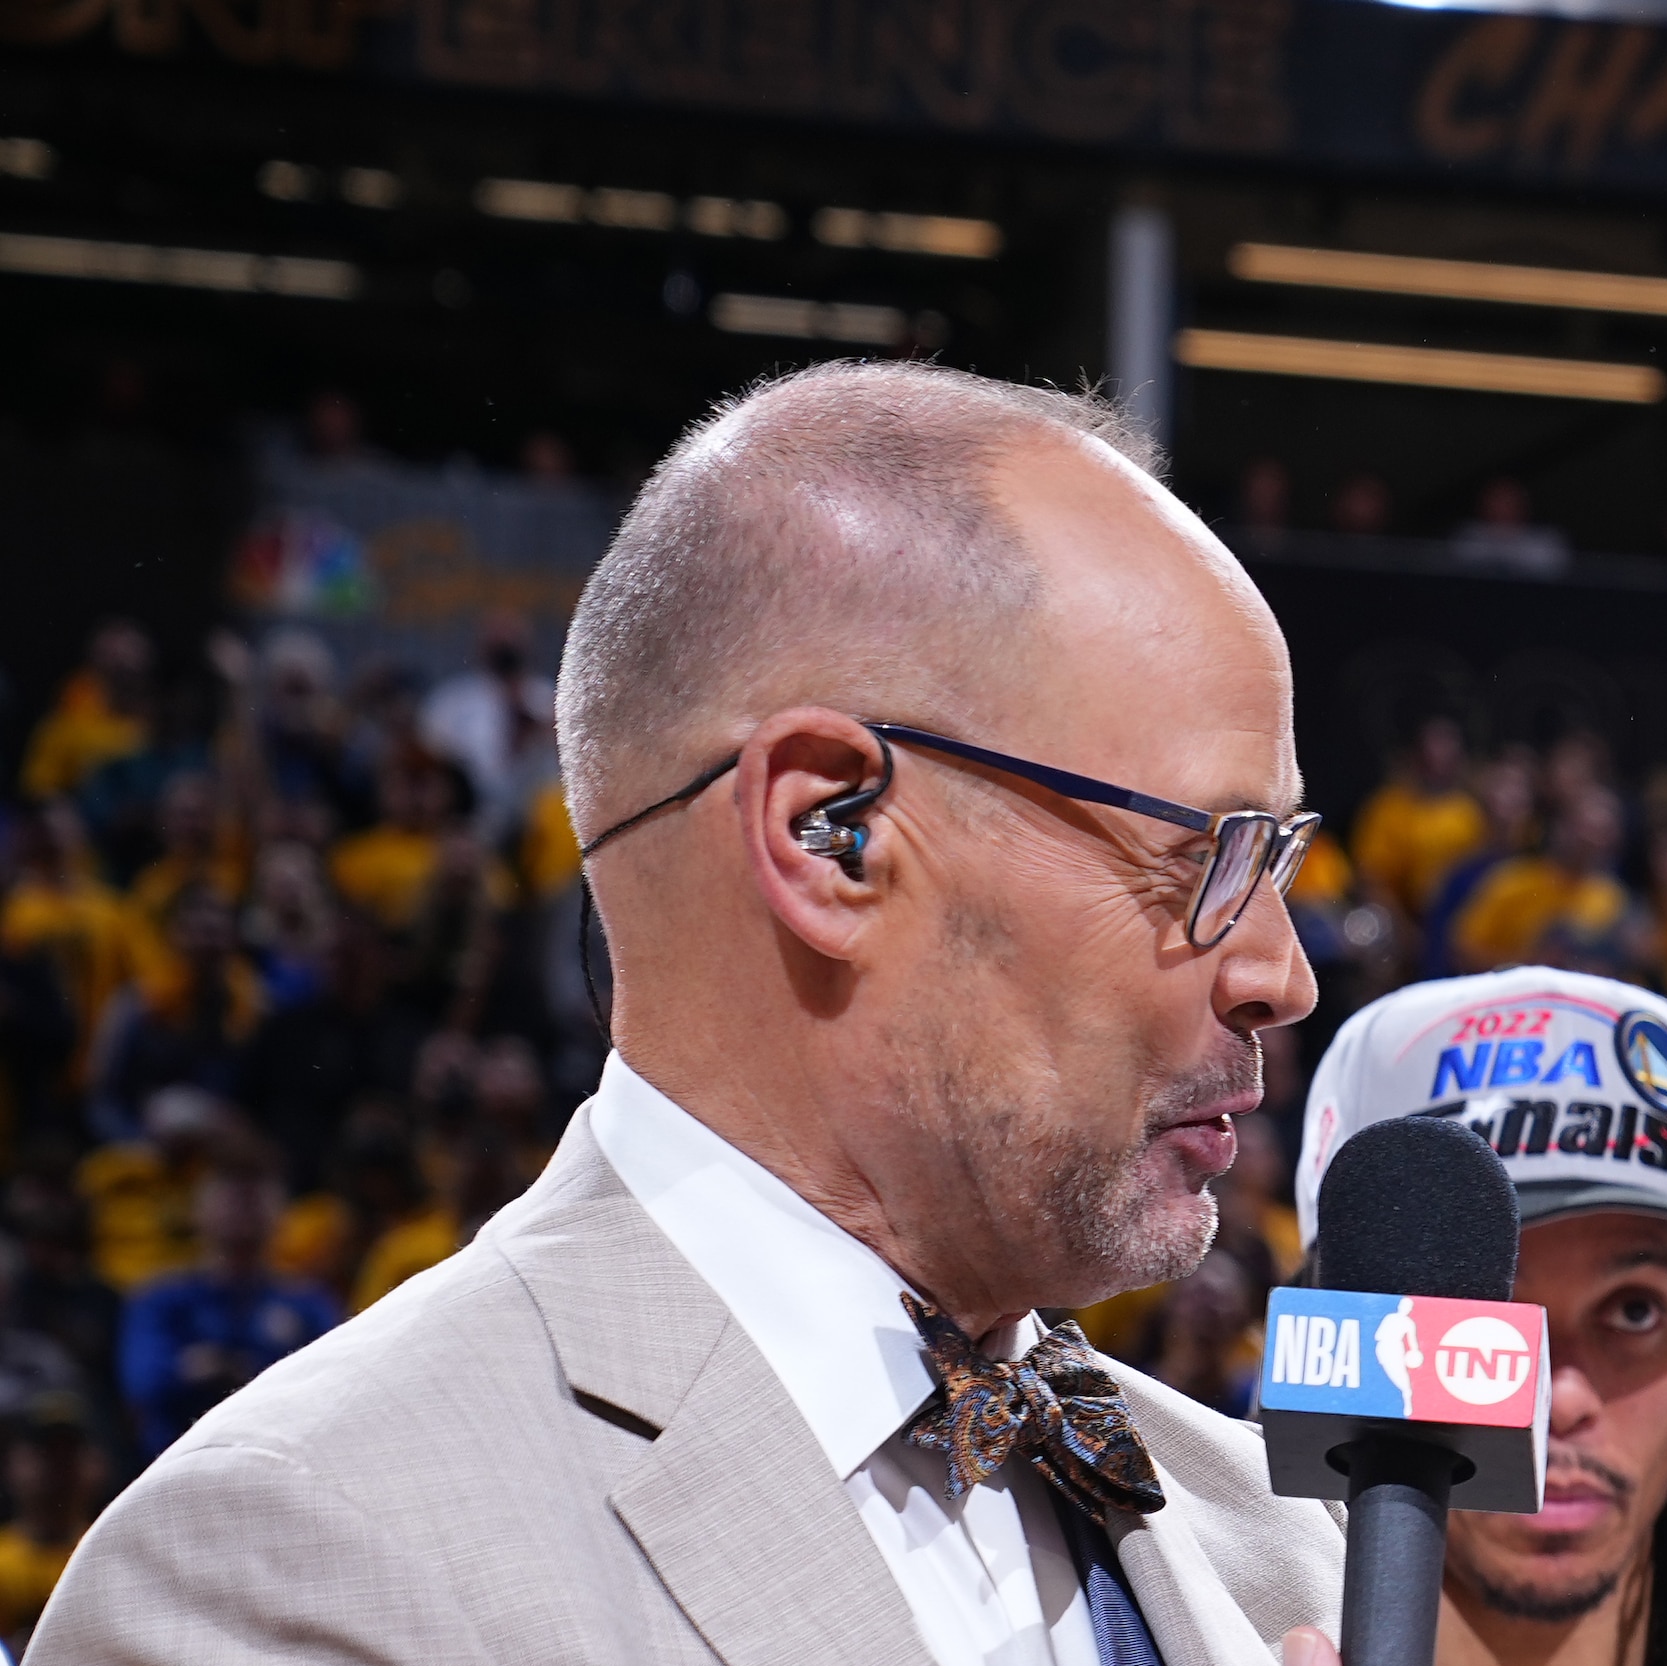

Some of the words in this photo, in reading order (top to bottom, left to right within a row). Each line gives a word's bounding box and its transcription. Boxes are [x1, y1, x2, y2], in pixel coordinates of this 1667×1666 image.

[1451, 1008, 1552, 1042] 2022
[1430, 1039, 1604, 1098] NBA
[1271, 1314, 1361, 1389] NBA
[1438, 1345, 1530, 1383] TNT
